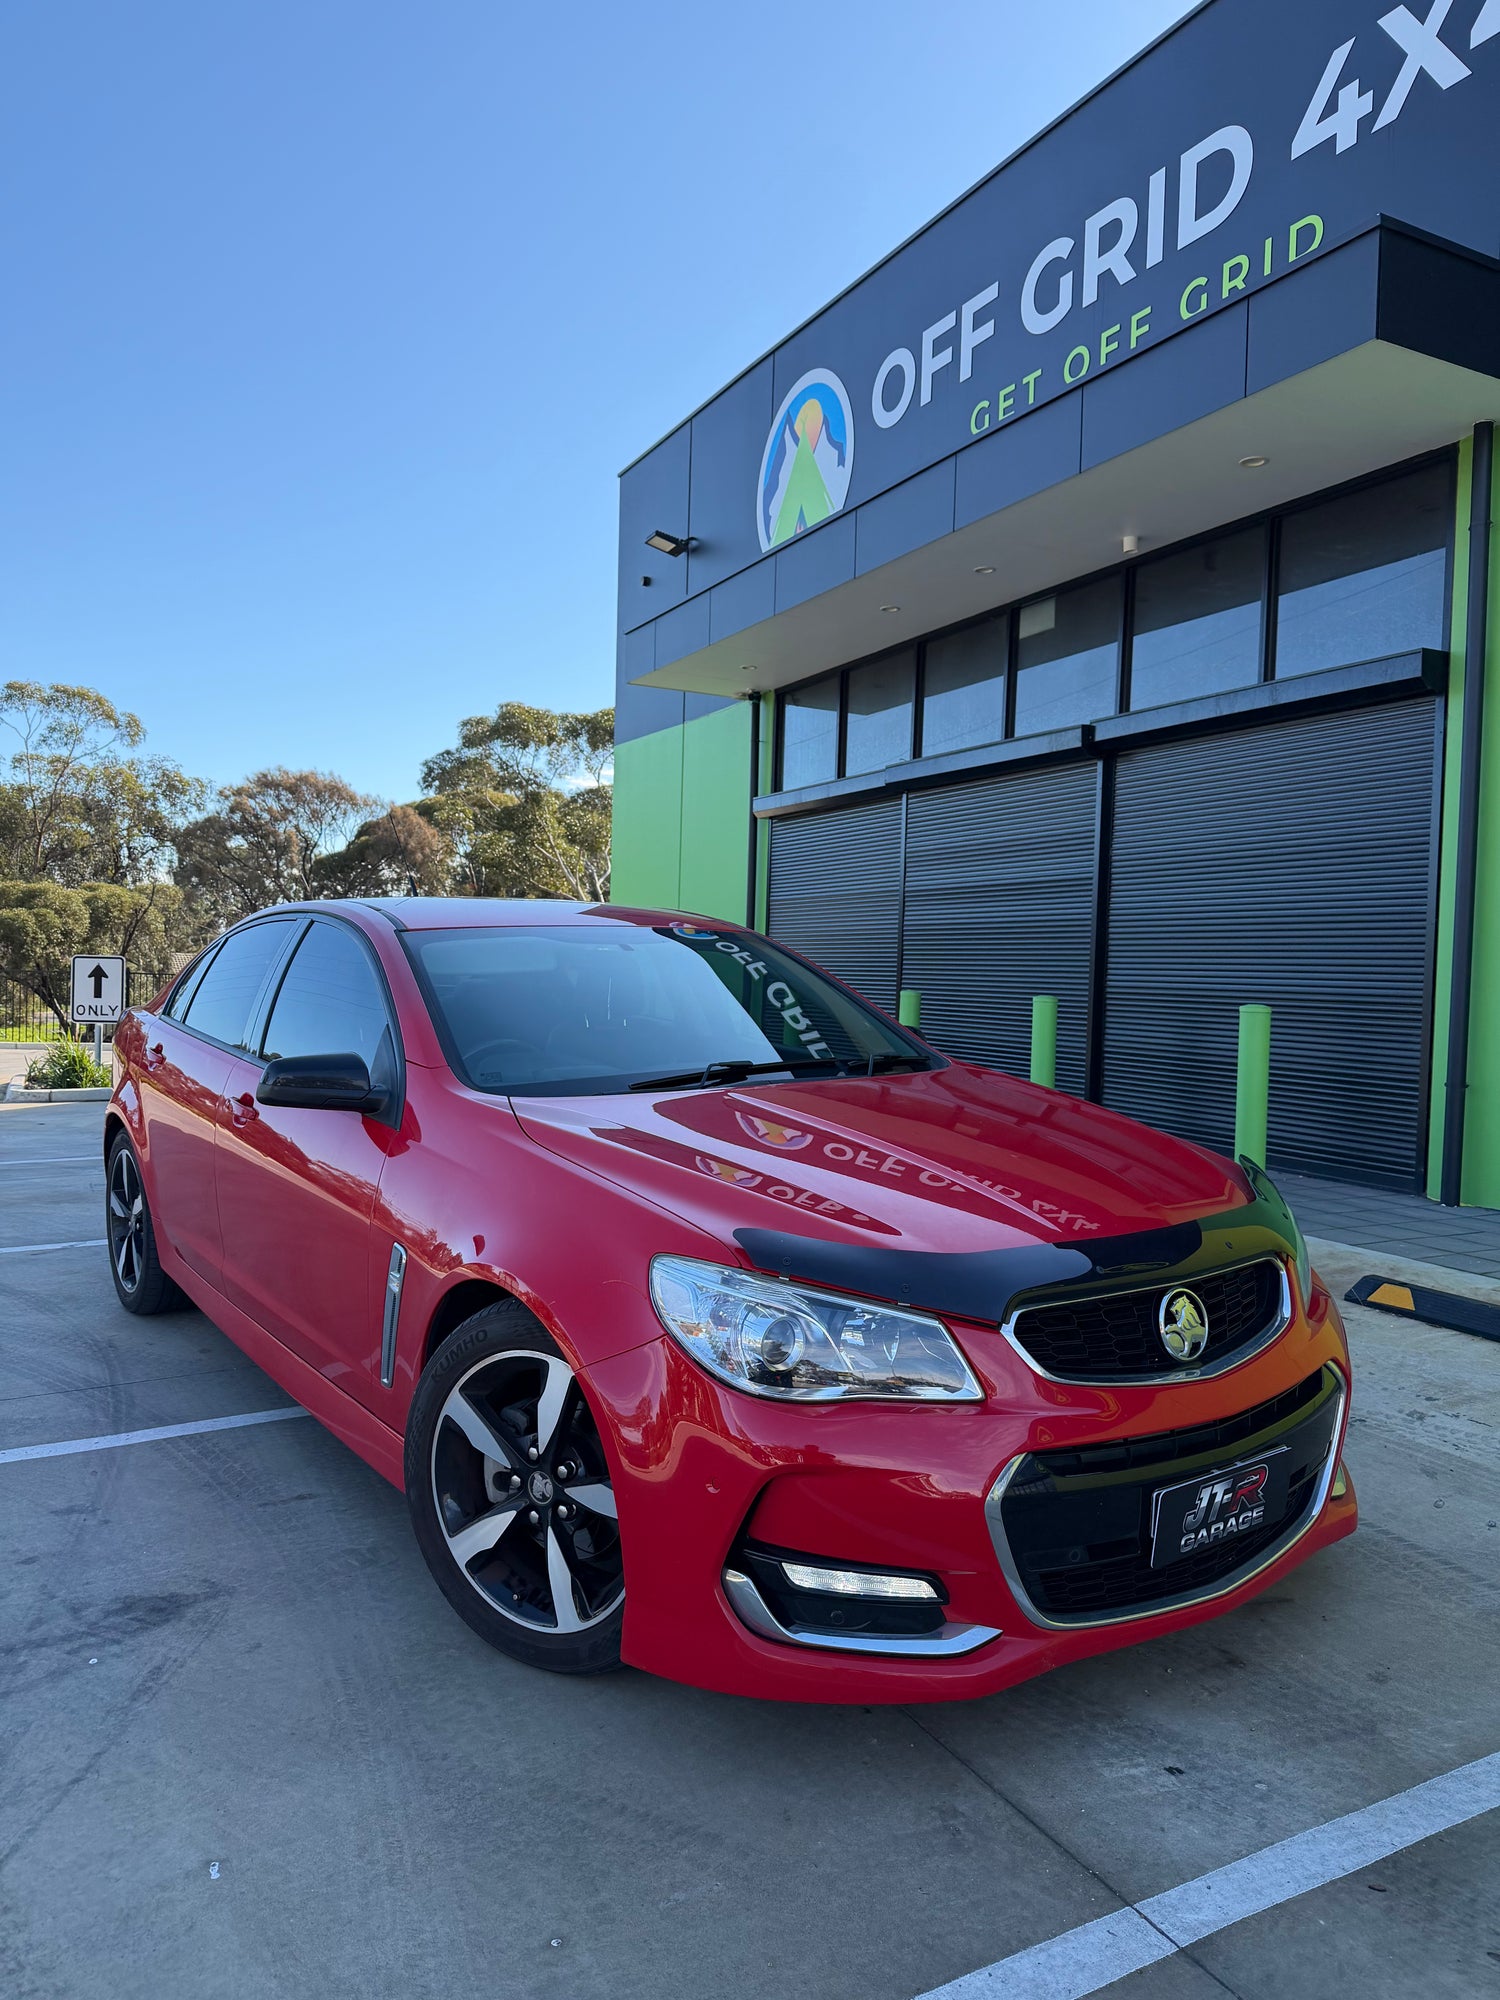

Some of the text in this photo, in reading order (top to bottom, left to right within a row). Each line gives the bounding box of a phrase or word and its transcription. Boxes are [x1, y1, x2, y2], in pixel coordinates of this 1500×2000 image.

[871, 282, 999, 429] OFF
[1020, 125, 1254, 336] GRID
[970, 214, 1326, 436] GET OFF GRID
[76, 1004, 118, 1016] ONLY
[431, 1329, 488, 1380] KUMHO
[1180, 1505, 1265, 1553] GARAGE
